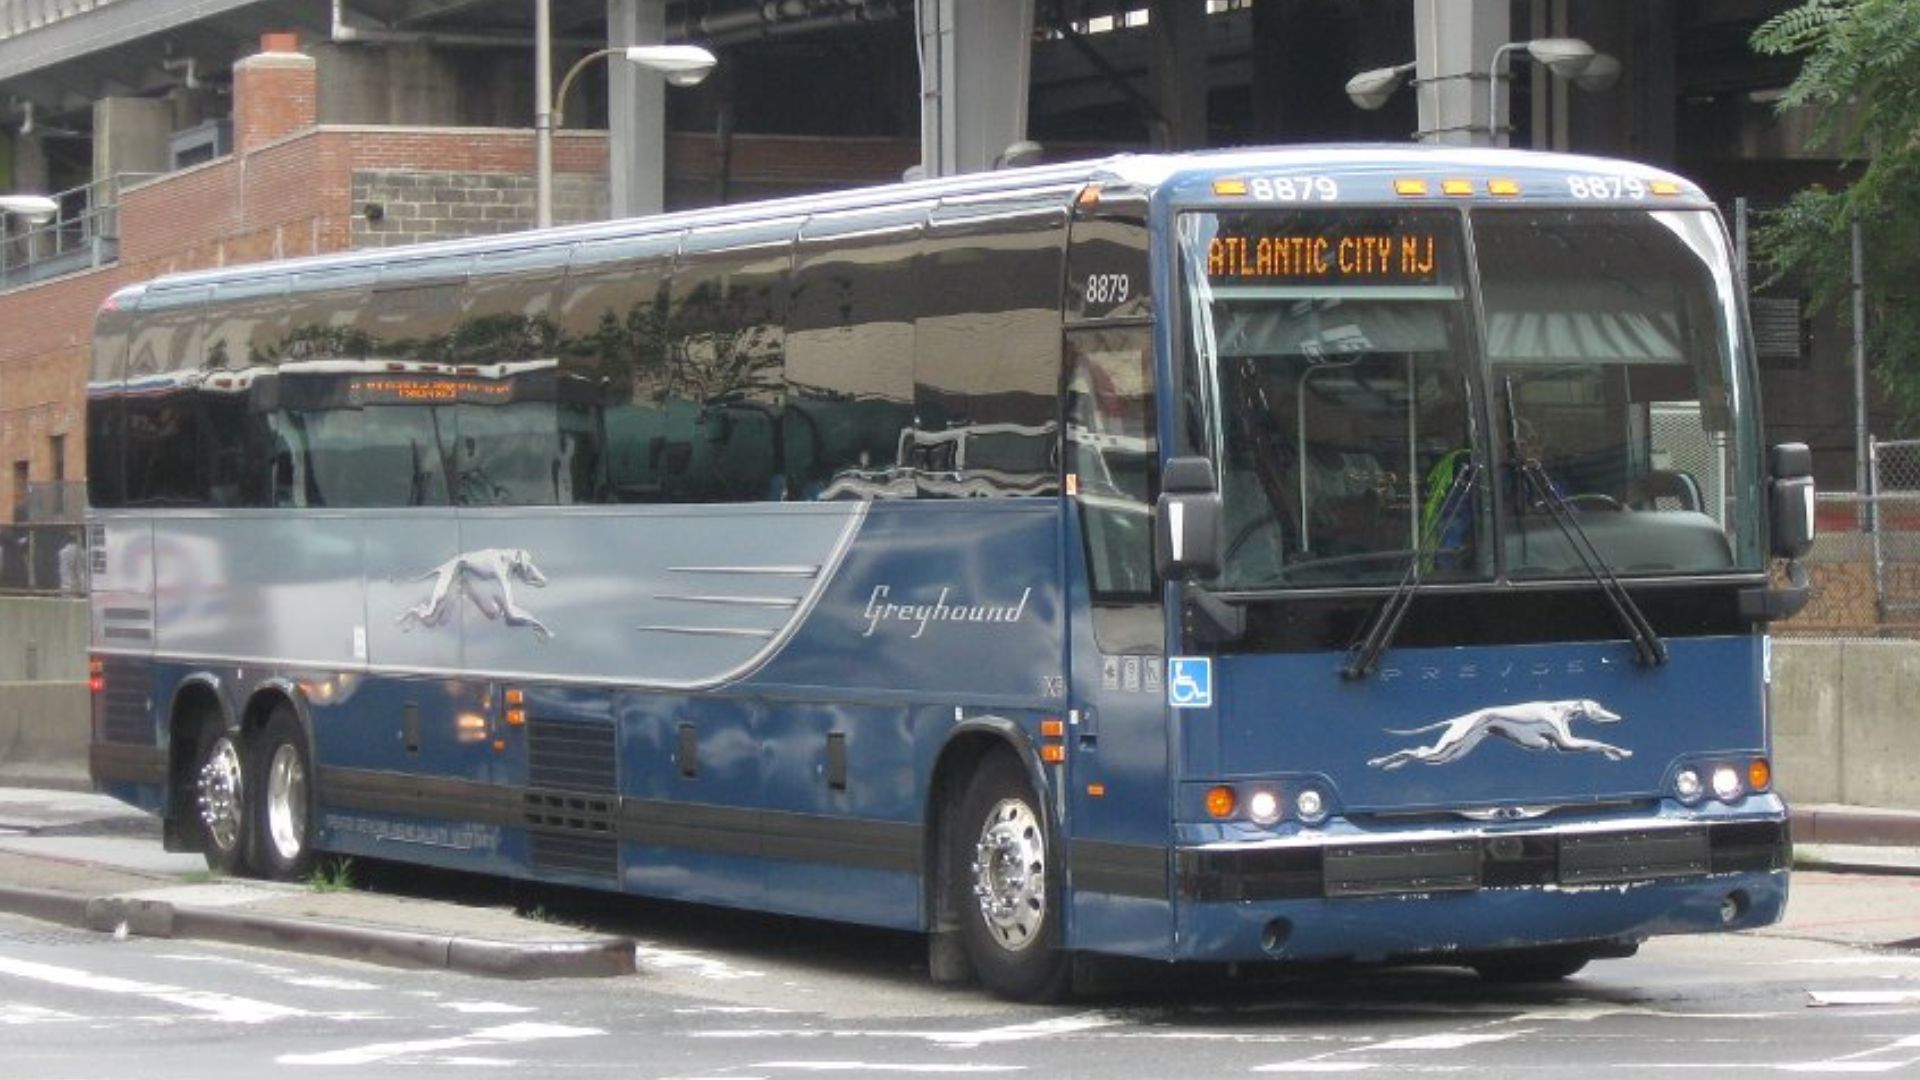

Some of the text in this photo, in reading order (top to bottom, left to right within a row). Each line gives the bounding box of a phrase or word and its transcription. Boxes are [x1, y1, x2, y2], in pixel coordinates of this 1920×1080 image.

[1251, 176, 1338, 201] 8879
[1567, 175, 1646, 199] 8879
[1207, 237, 1434, 275] ATLANTIC CITY NJ
[1086, 273, 1129, 302] 8879
[862, 585, 1032, 638] Greyhound
